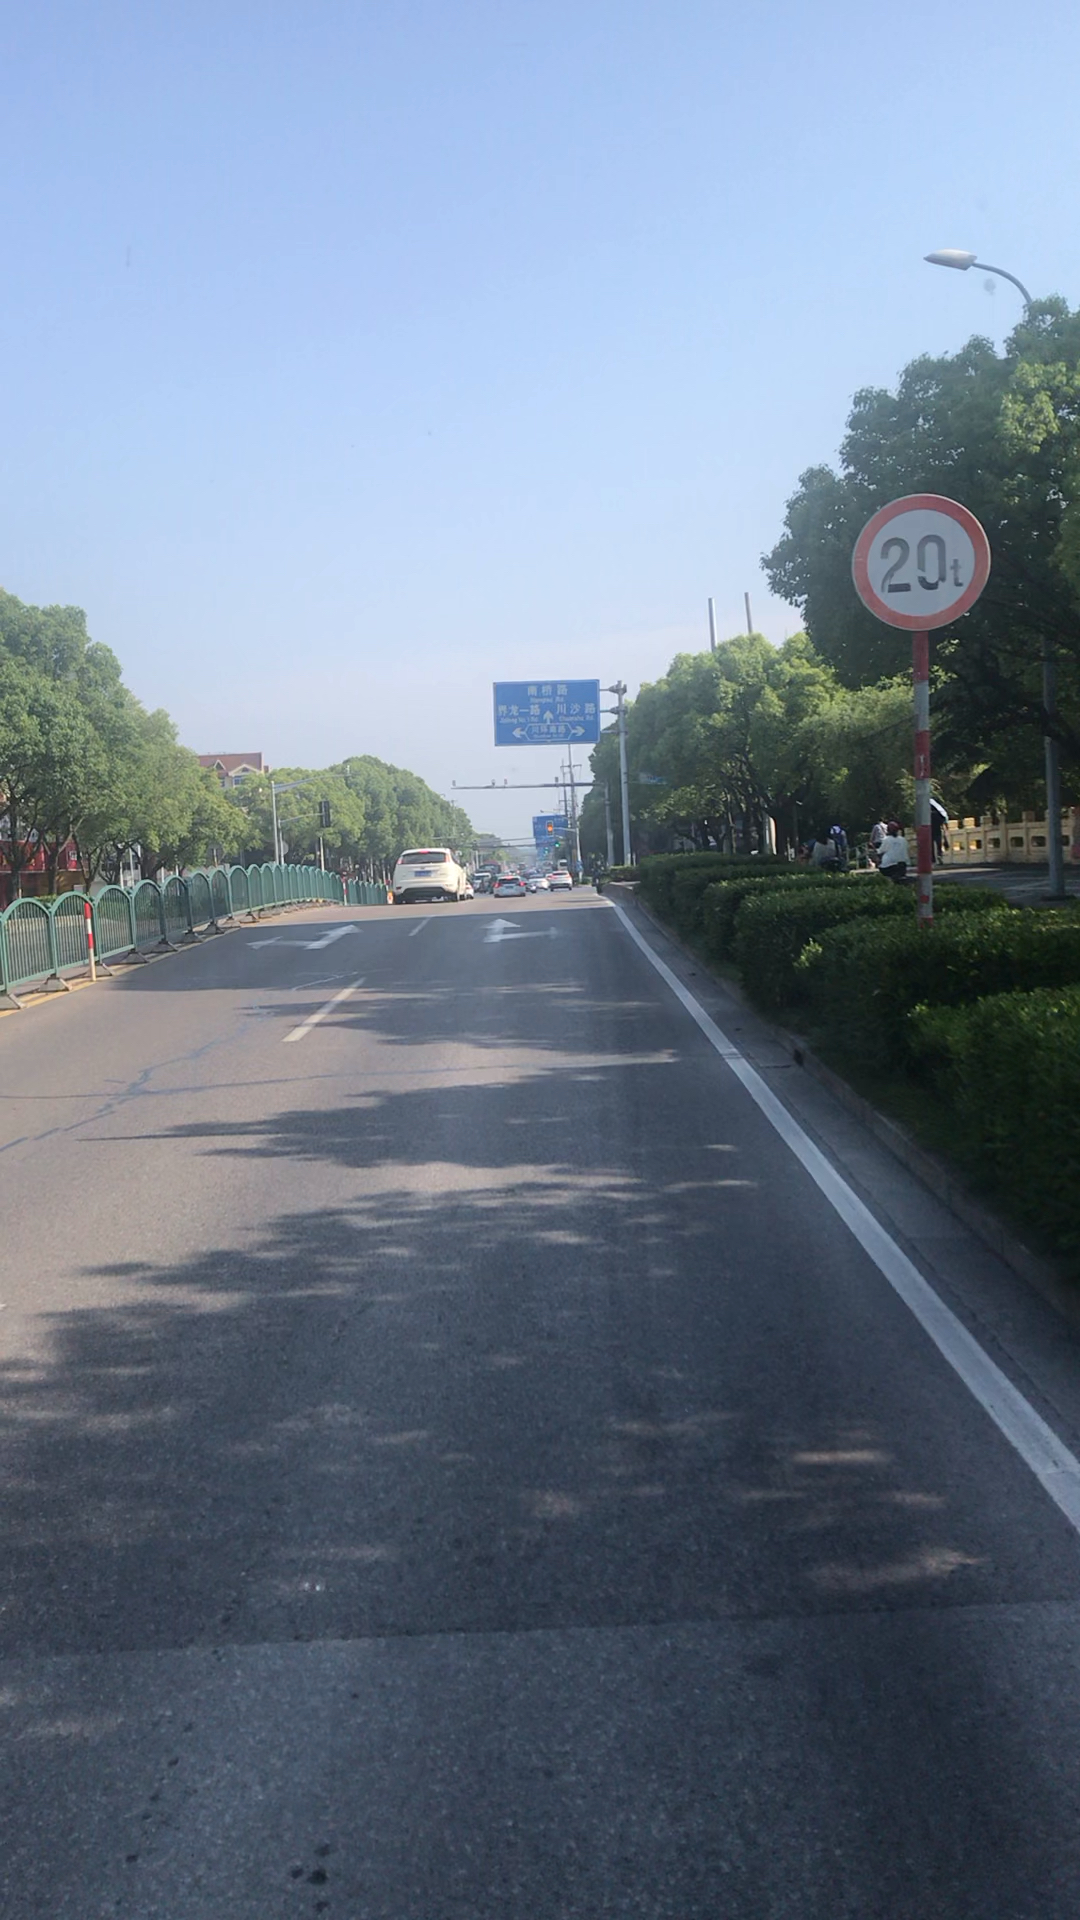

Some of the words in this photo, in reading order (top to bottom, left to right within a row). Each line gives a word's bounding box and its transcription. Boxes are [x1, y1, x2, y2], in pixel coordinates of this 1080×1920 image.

[498, 704, 541, 716] 界龙一路
[556, 703, 596, 715] 川沙路
